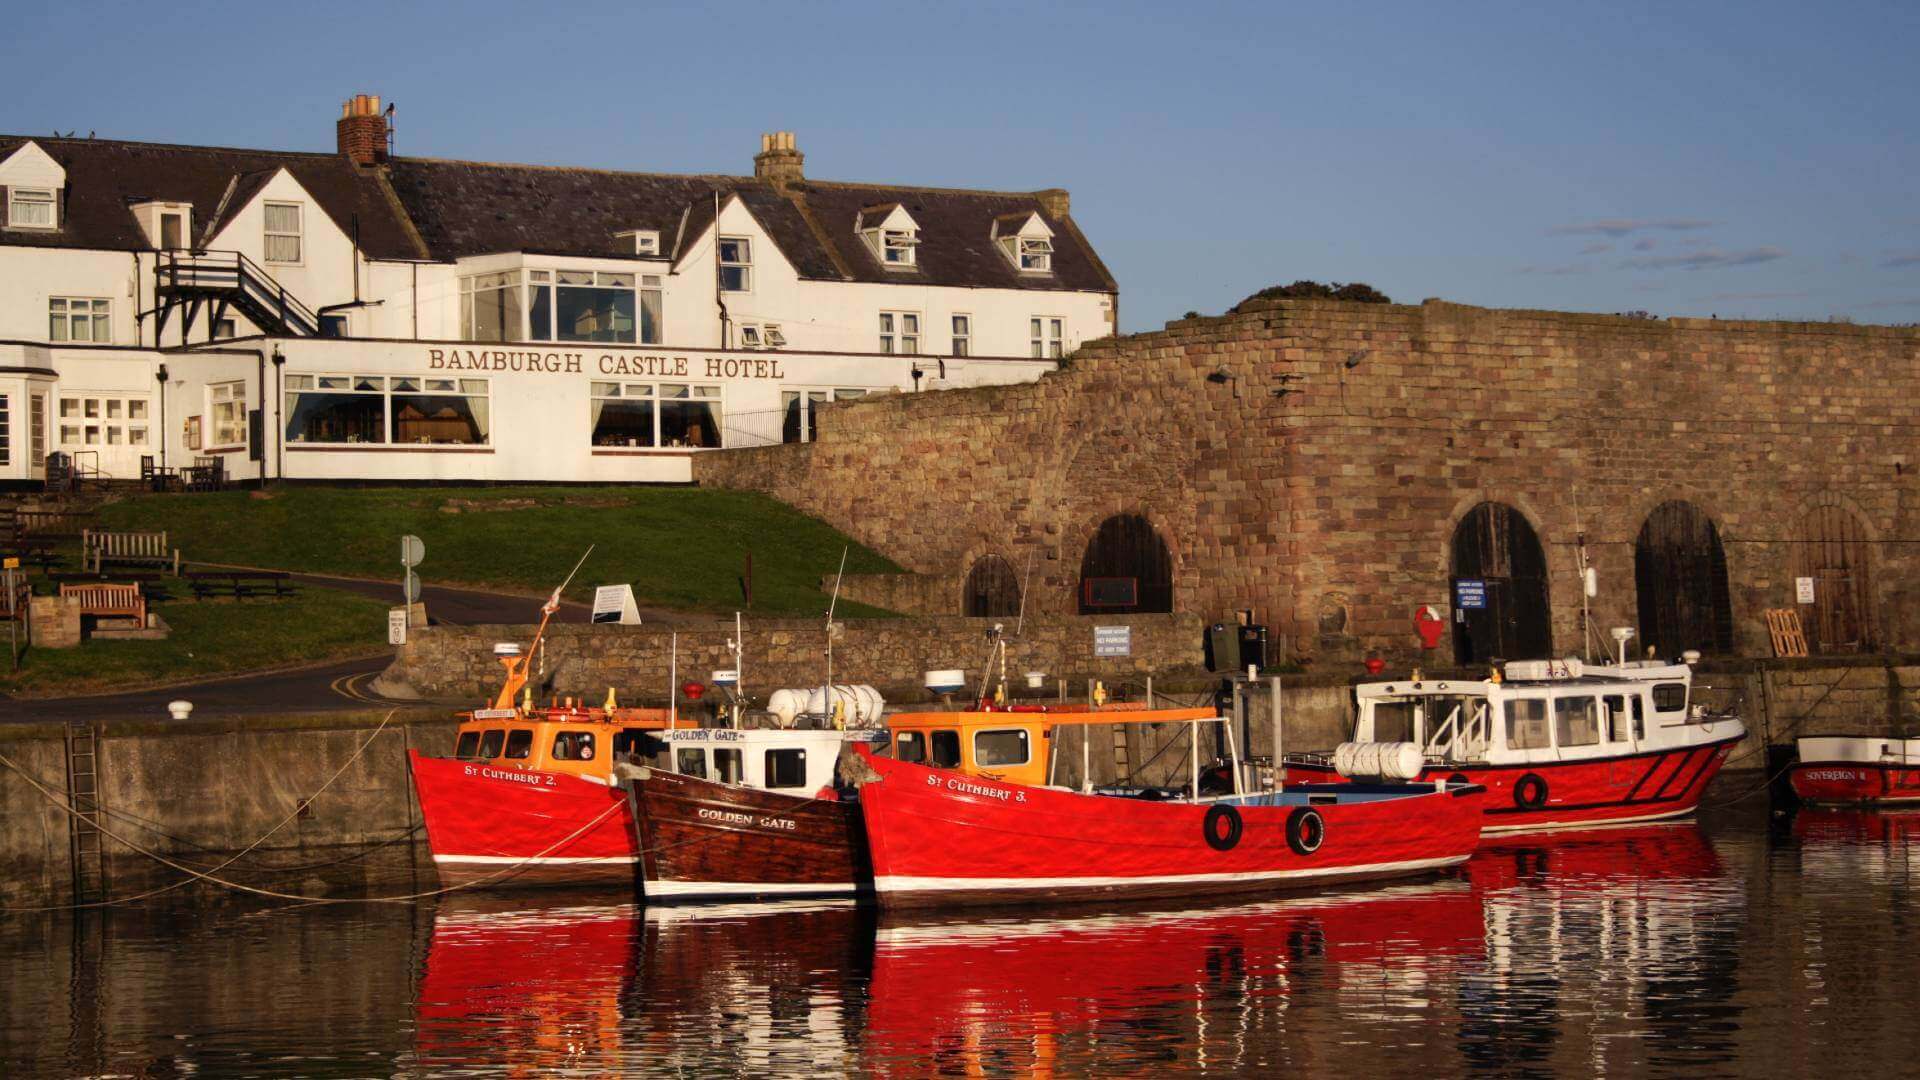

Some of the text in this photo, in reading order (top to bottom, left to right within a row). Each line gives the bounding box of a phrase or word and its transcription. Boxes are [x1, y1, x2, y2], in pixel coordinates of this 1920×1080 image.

[429, 349, 785, 380] BAMBURGH CASTLE HOTEL
[672, 729, 738, 742] GOLDEN GATE
[482, 767, 541, 785] CUTHBERT
[947, 779, 1012, 801] CUTHBERT
[698, 808, 796, 830] GOLDEN GATE
